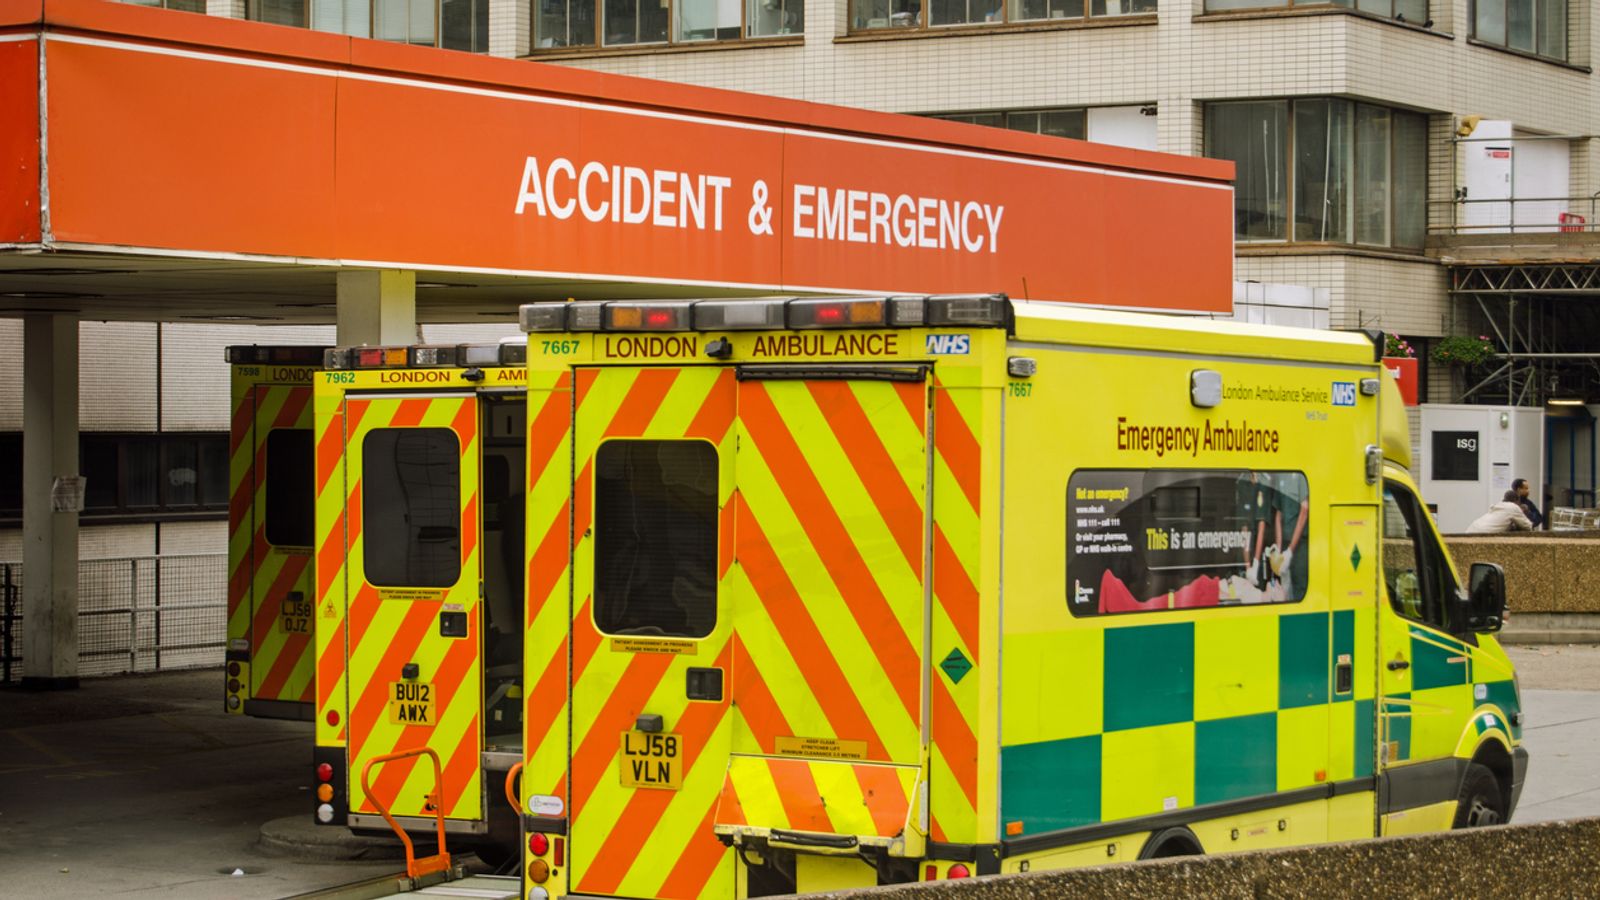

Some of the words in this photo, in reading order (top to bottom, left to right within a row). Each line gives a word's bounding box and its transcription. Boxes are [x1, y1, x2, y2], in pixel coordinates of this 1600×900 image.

[514, 156, 731, 232] ACCIDENT
[747, 179, 774, 235] &
[793, 183, 1004, 253] EMERGENCY
[541, 340, 580, 354] 7667
[605, 336, 697, 358] LONDON
[752, 333, 899, 357] AMBULANCE
[926, 334, 970, 355] NHS
[273, 367, 316, 382] LONDO
[325, 371, 356, 384] 7962
[380, 370, 451, 384] LONDON
[1008, 382, 1032, 397] 7667
[1222, 381, 1253, 400] London
[1255, 384, 1300, 403] Ambulance
[1301, 388, 1328, 404] Service
[1332, 382, 1356, 406] NHS
[1117, 416, 1200, 457] Emergency
[1203, 419, 1279, 453] Ambulance
[1146, 527, 1169, 550] This
[1170, 527, 1181, 549] is
[1182, 532, 1196, 549] an
[1197, 530, 1252, 552] emergency
[282, 601, 311, 617] LJ58
[396, 683, 430, 702] BU12
[398, 704, 428, 722] AWX
[625, 733, 677, 758] LJ58
[632, 759, 670, 783] VLN
